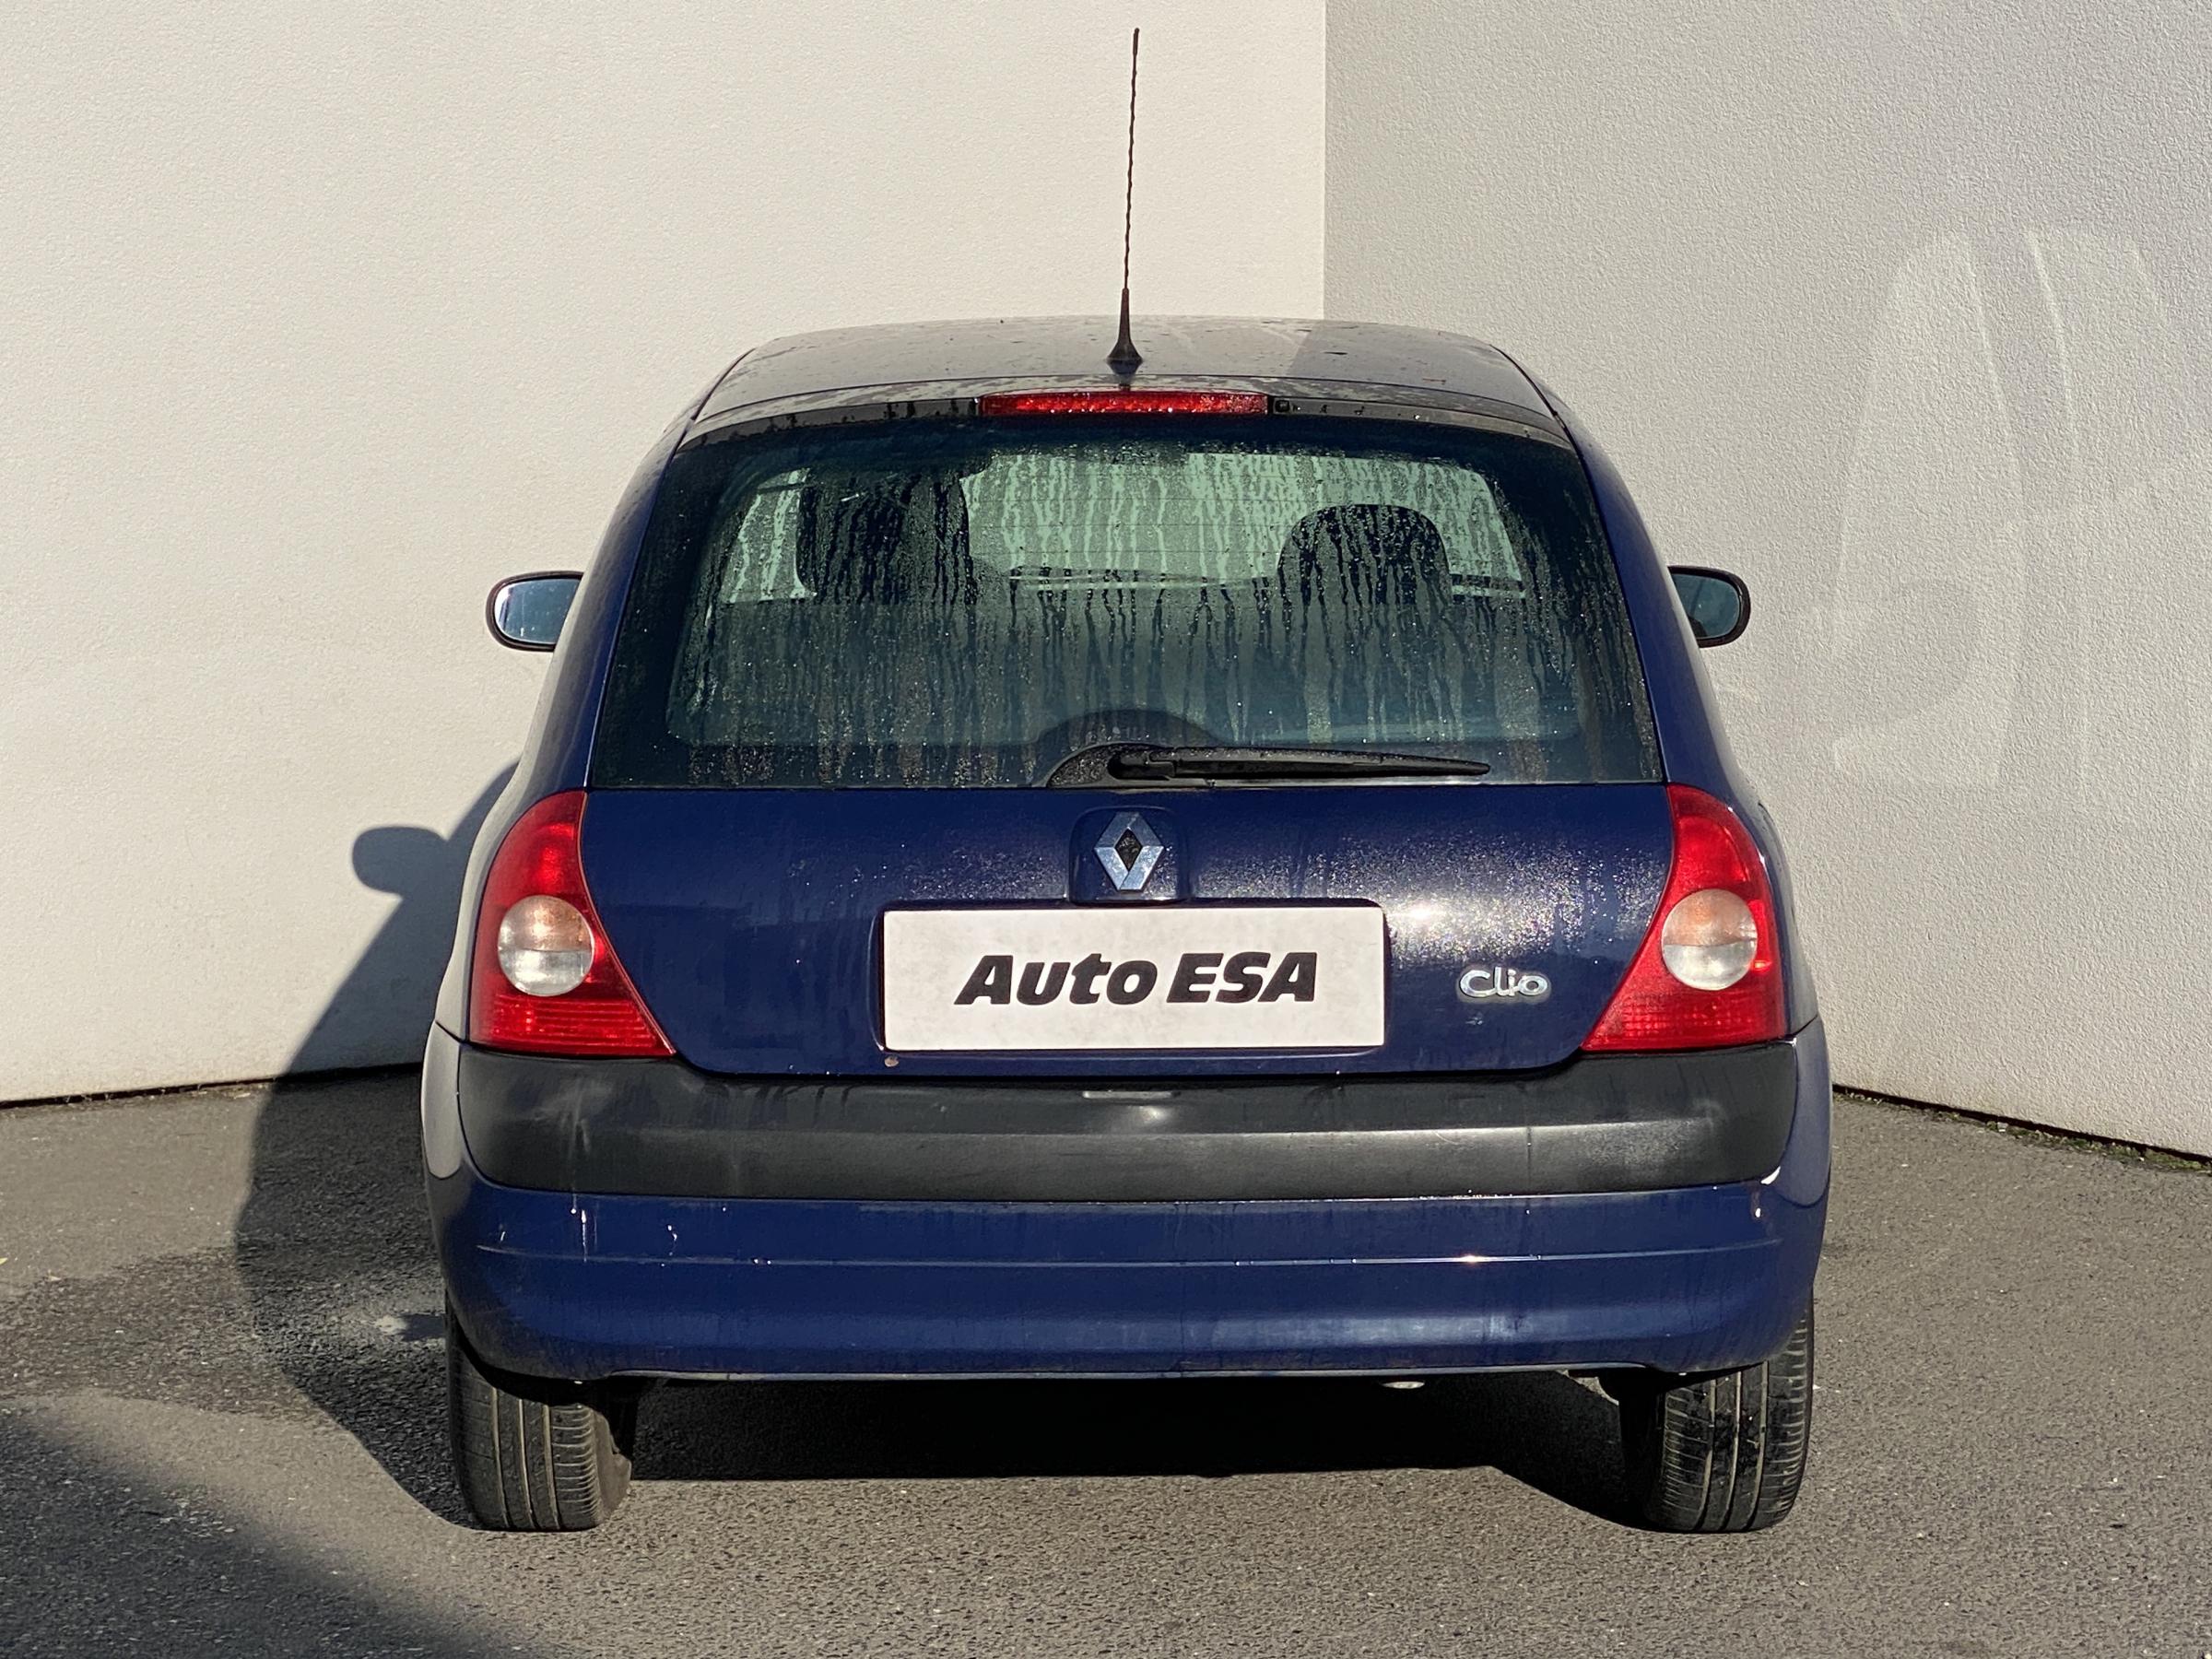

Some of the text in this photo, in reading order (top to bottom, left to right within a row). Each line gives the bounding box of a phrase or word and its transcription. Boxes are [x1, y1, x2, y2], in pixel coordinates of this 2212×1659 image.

[954, 952, 1318, 1006] Auto ESA
[1459, 966, 1549, 997] Clio
